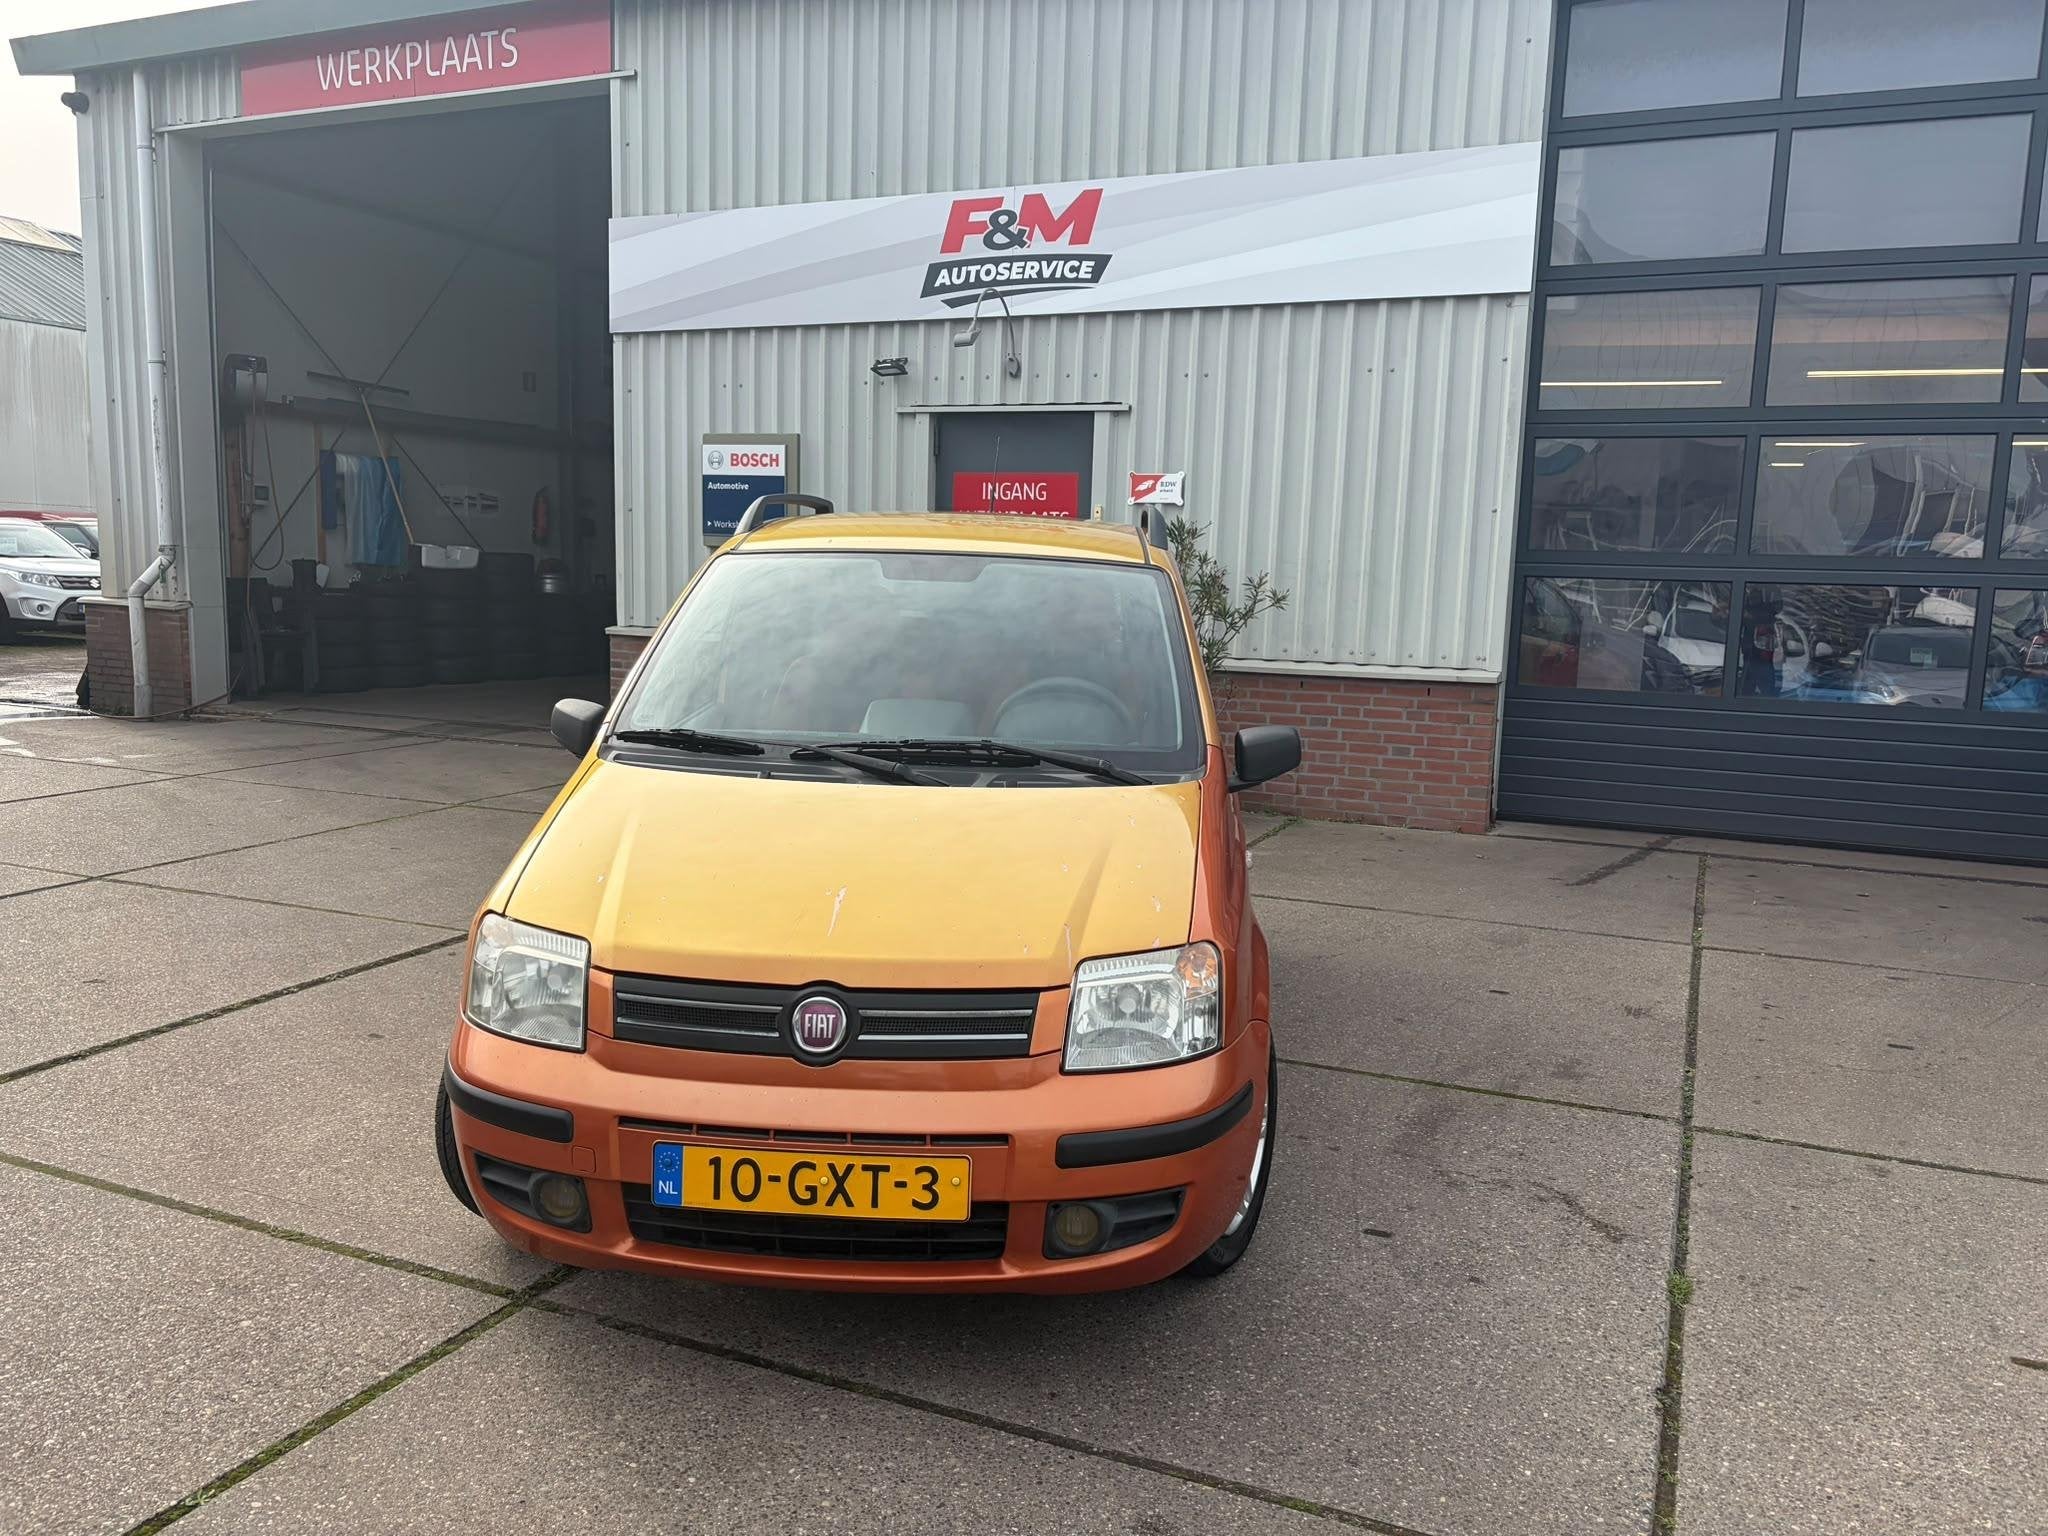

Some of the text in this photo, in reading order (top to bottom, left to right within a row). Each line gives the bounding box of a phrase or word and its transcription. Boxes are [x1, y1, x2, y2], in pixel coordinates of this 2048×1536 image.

[317, 28, 519, 91] WERKPLAATS
[940, 188, 1104, 254] F&M
[934, 260, 1095, 287] AUTOSERVICE
[730, 453, 780, 467] BOSCH
[707, 482, 750, 490] Automotive
[982, 482, 1047, 500] INGANG
[804, 1013, 836, 1039] FIAT
[658, 1180, 678, 1195] NL
[708, 1156, 940, 1211] 10-GXT-3
